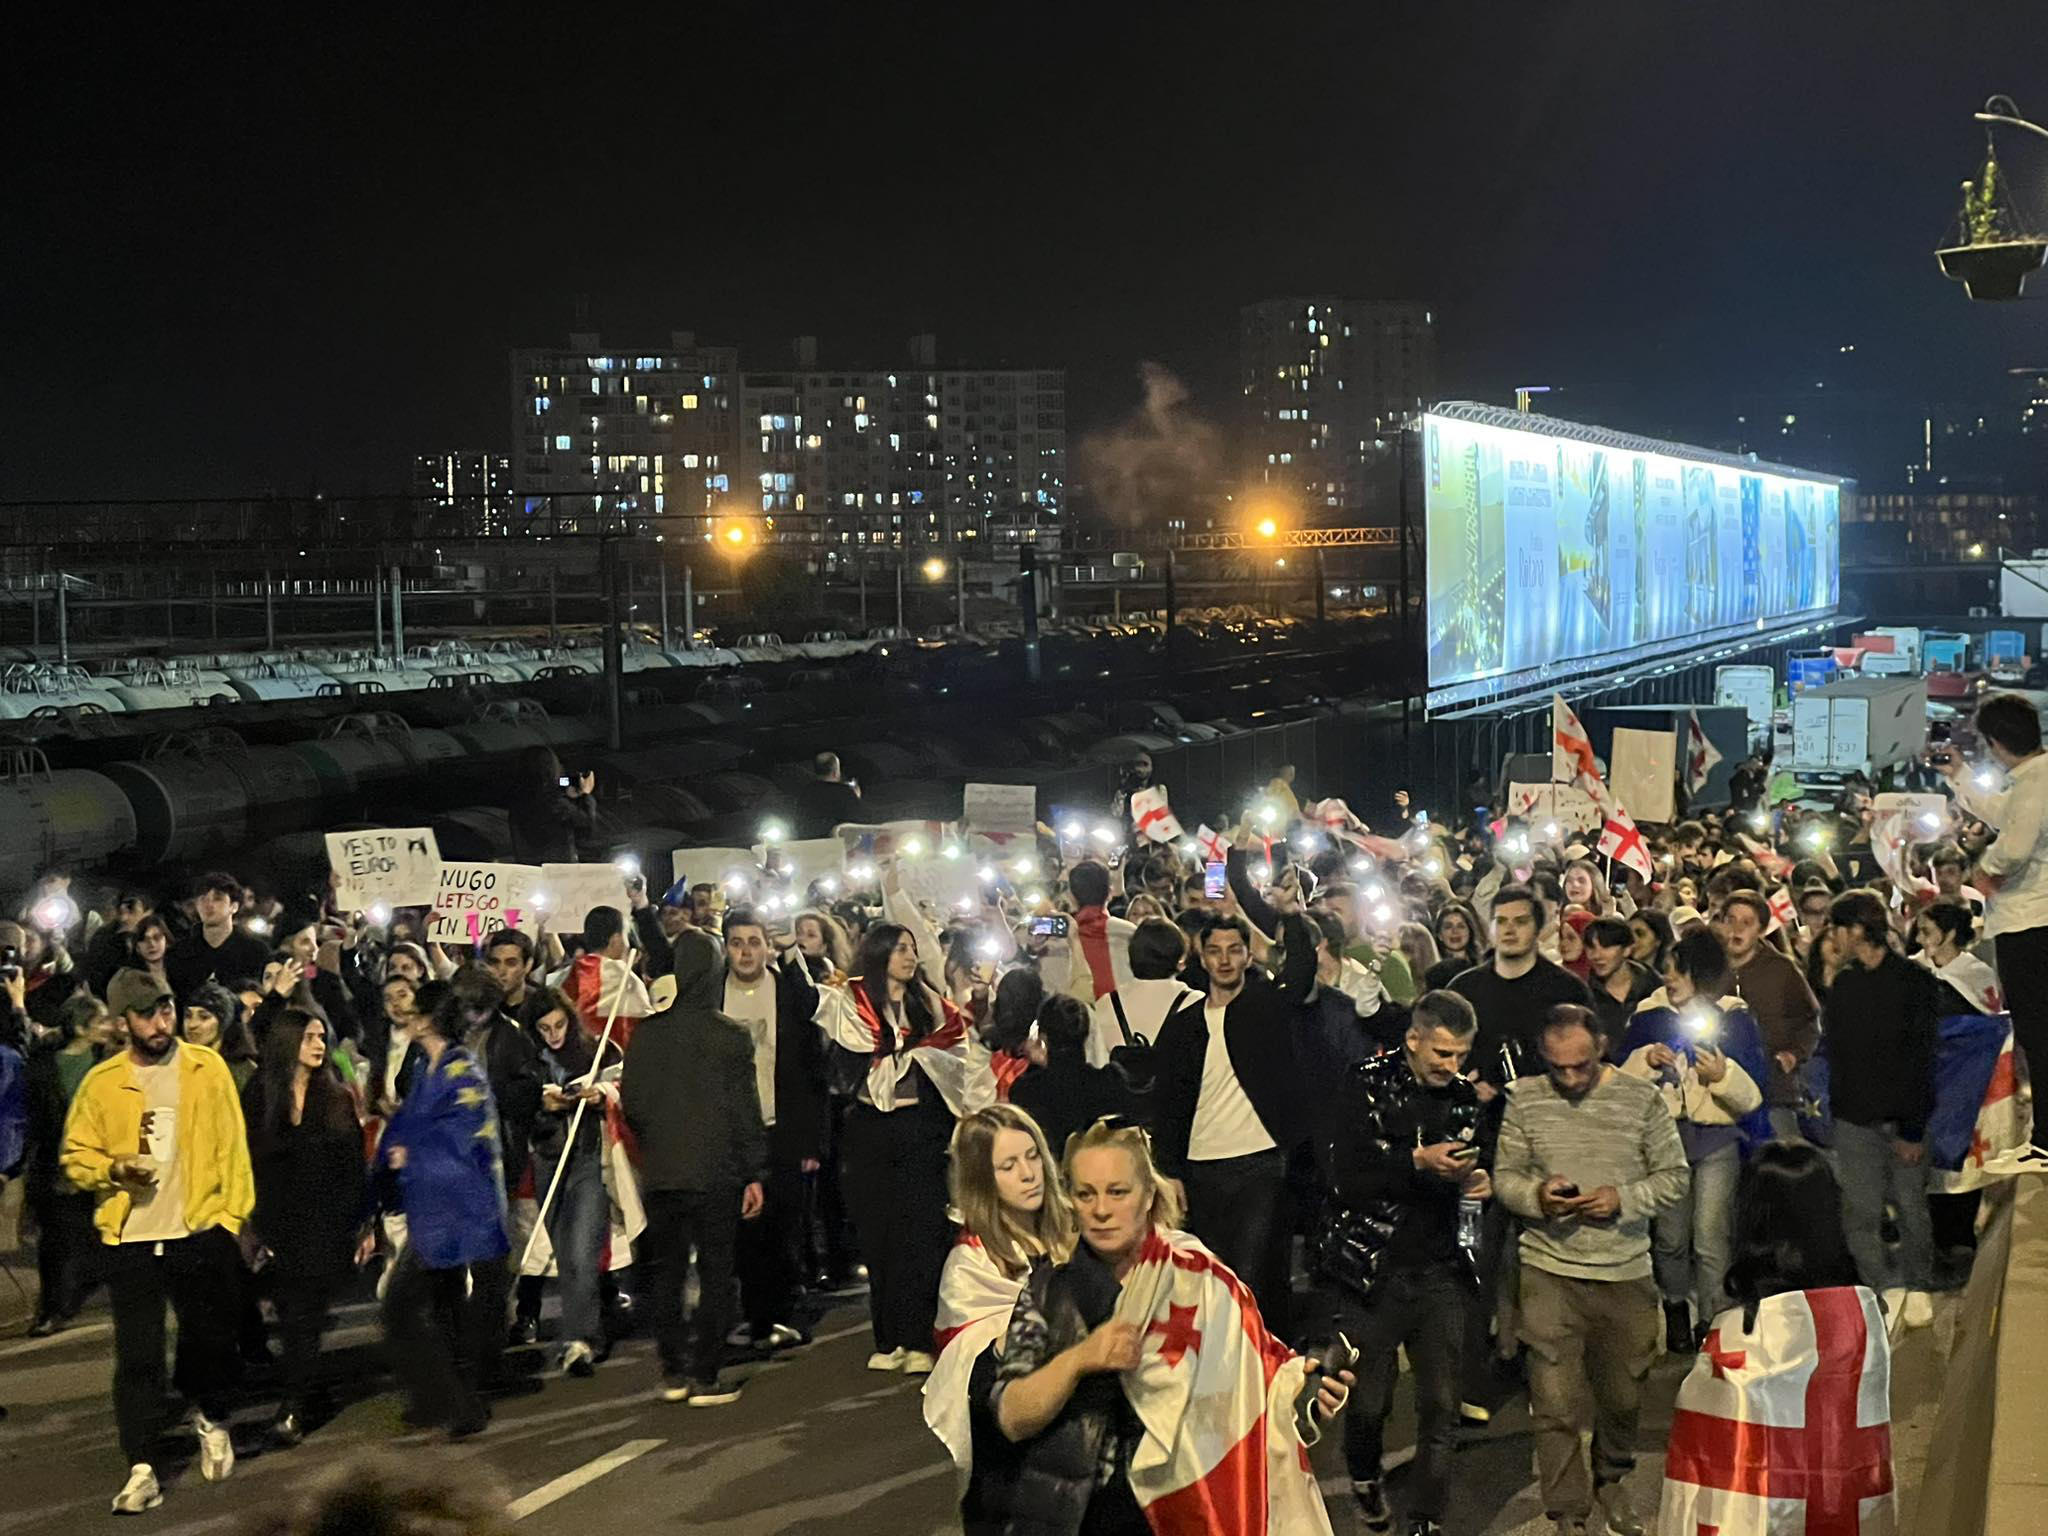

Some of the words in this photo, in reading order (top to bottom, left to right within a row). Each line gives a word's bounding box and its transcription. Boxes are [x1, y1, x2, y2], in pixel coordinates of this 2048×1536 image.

[341, 837, 374, 857] YES
[376, 836, 397, 852] TO
[440, 869, 496, 891] NUGO
[436, 892, 474, 909] LETS
[476, 894, 499, 911] GO
[436, 916, 458, 936] IN
[465, 916, 523, 937] URO
